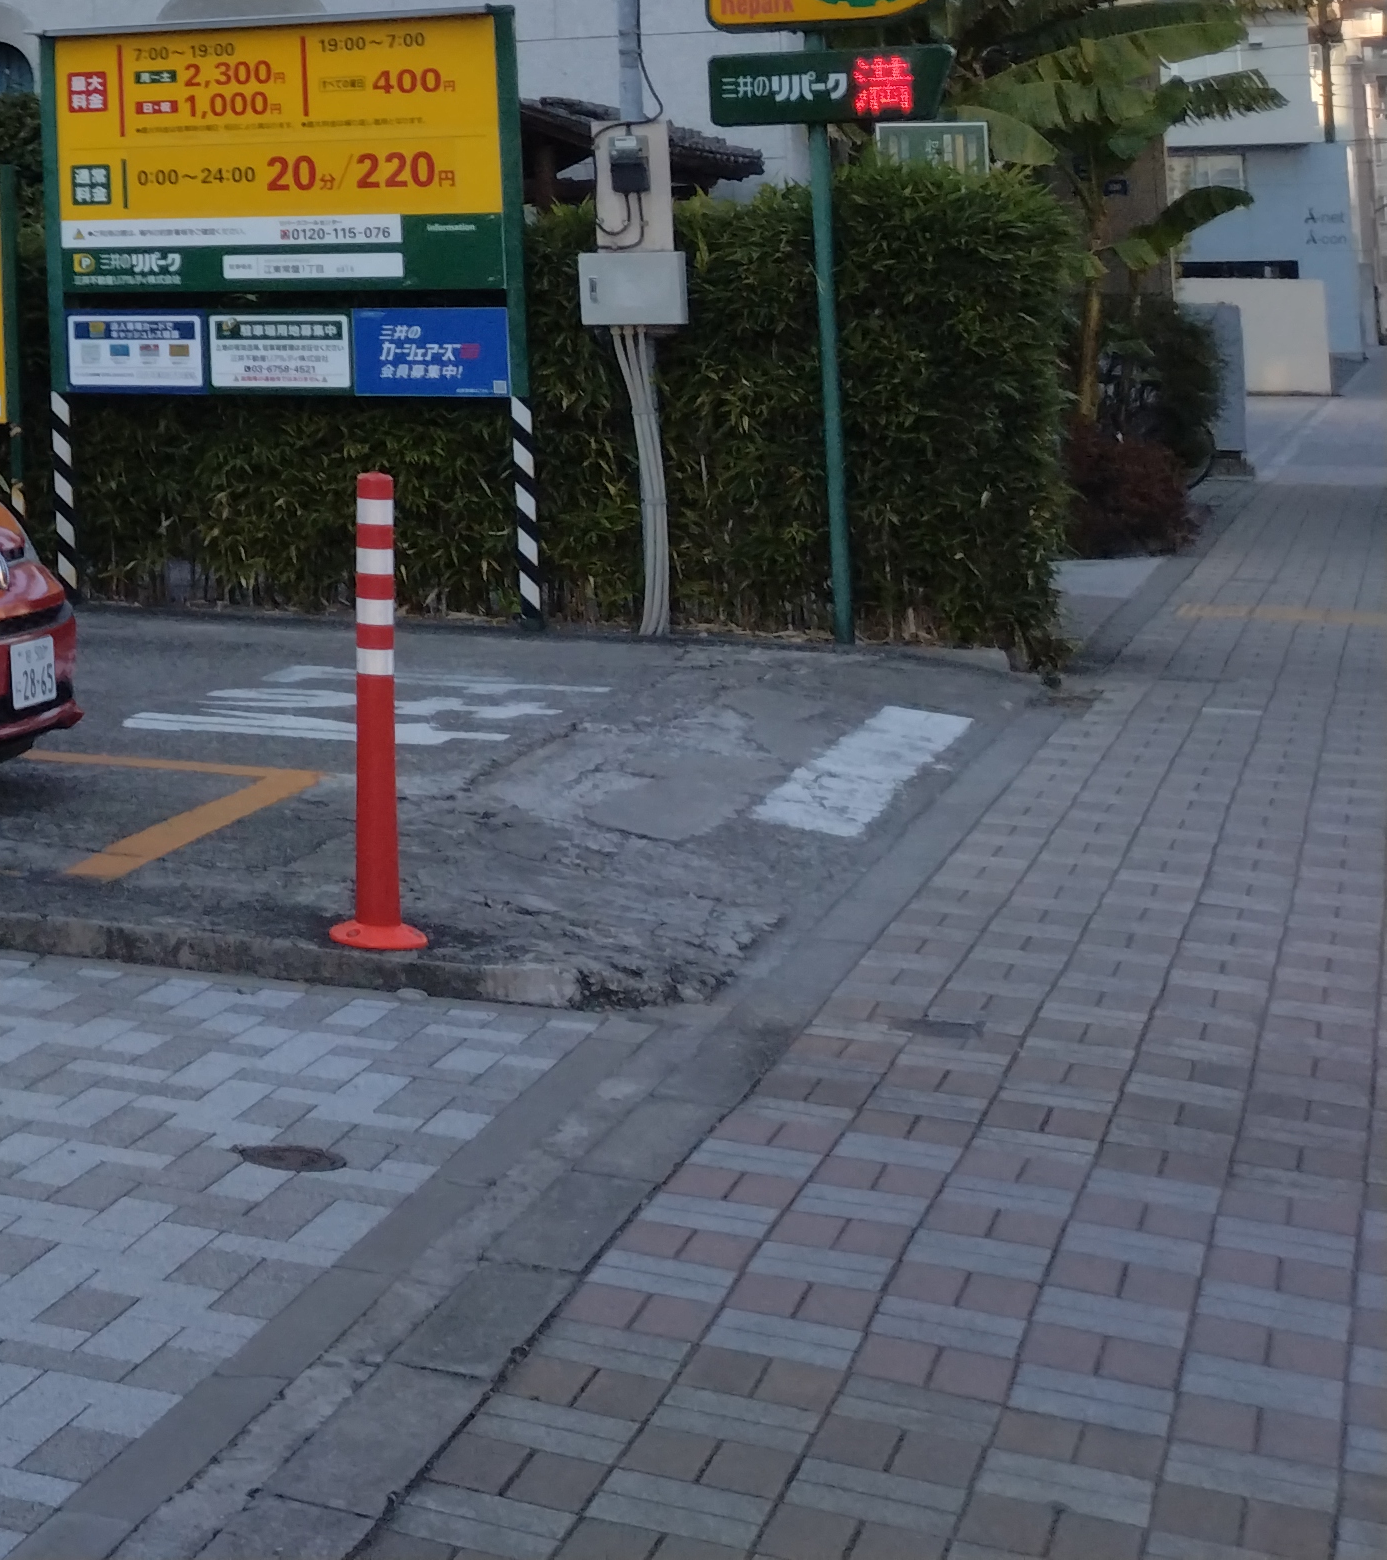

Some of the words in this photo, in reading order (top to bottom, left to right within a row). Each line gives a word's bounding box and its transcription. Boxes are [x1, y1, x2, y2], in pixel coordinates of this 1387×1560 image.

[184, 60, 286, 88] 2,300円
[372, 68, 456, 94] 400円
[721, 71, 847, 101] 三井のリパーク
[853, 55, 914, 114] 満
[184, 91, 282, 119] 1,000円
[291, 227, 391, 240] 0120-115-076
[99, 252, 182, 273] 三井のリパーク
[379, 325, 422, 340] 三井の
[122, 665, 613, 745] 止まれ
